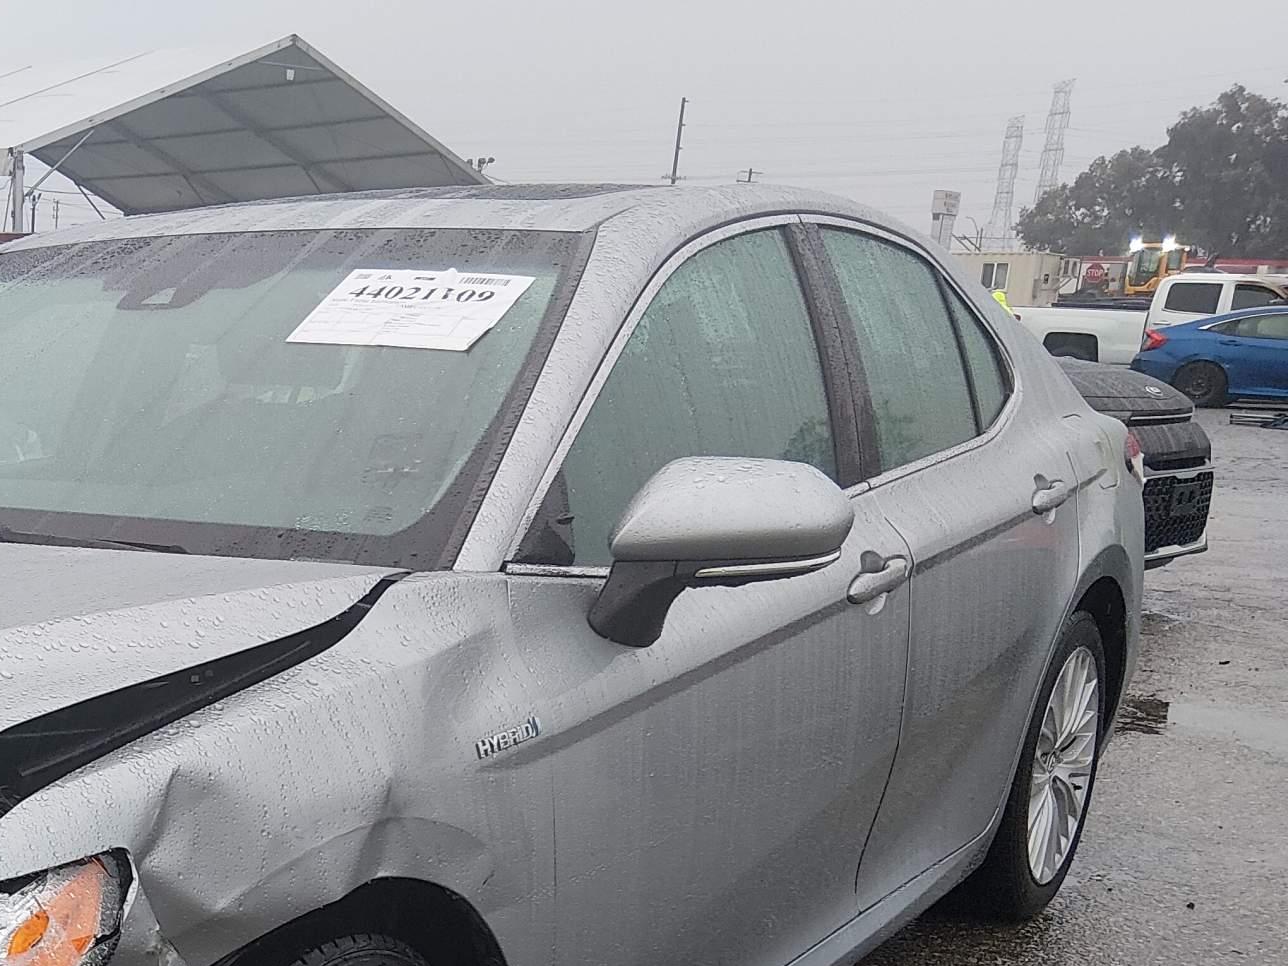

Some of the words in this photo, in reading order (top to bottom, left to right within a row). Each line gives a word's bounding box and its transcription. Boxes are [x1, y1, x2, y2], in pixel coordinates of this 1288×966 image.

[1086, 269, 1104, 278] STOP
[348, 284, 496, 303] 44021109
[475, 719, 537, 760] HYBRID
